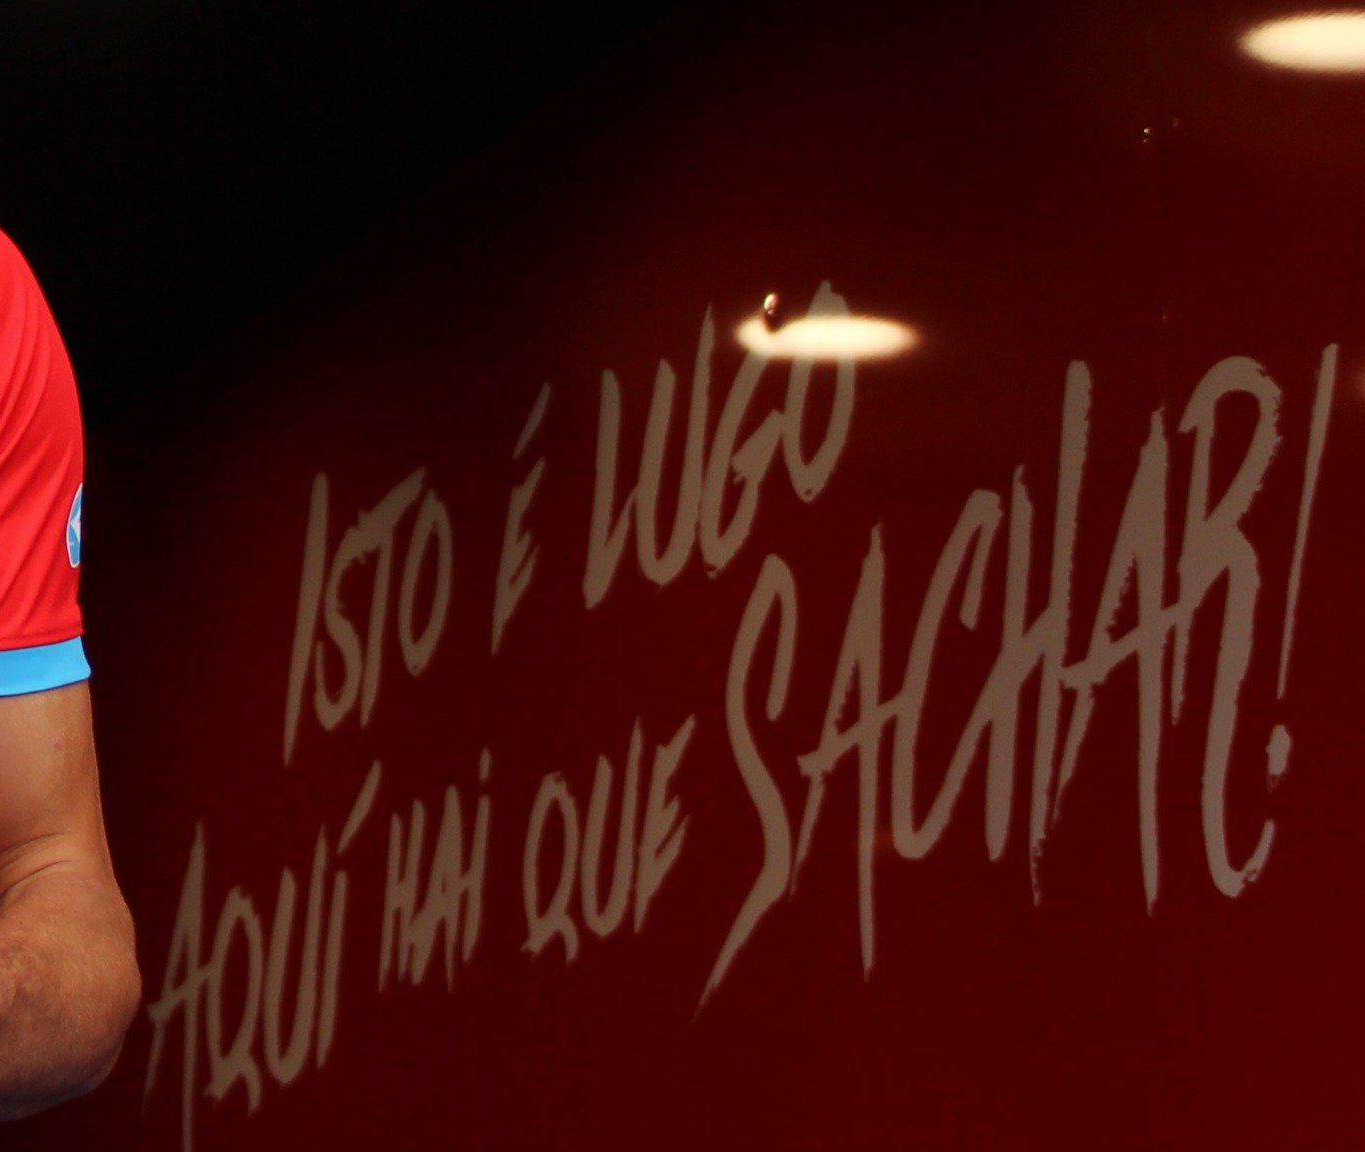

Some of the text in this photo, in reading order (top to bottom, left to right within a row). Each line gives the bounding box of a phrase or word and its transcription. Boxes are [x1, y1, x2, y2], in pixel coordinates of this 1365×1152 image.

[141, 756, 383, 1152] AQUÍ
[520, 712, 698, 967] QUE
[688, 342, 1340, 1030] SACHAR!
[282, 278, 857, 769] ISTO É LUGO
